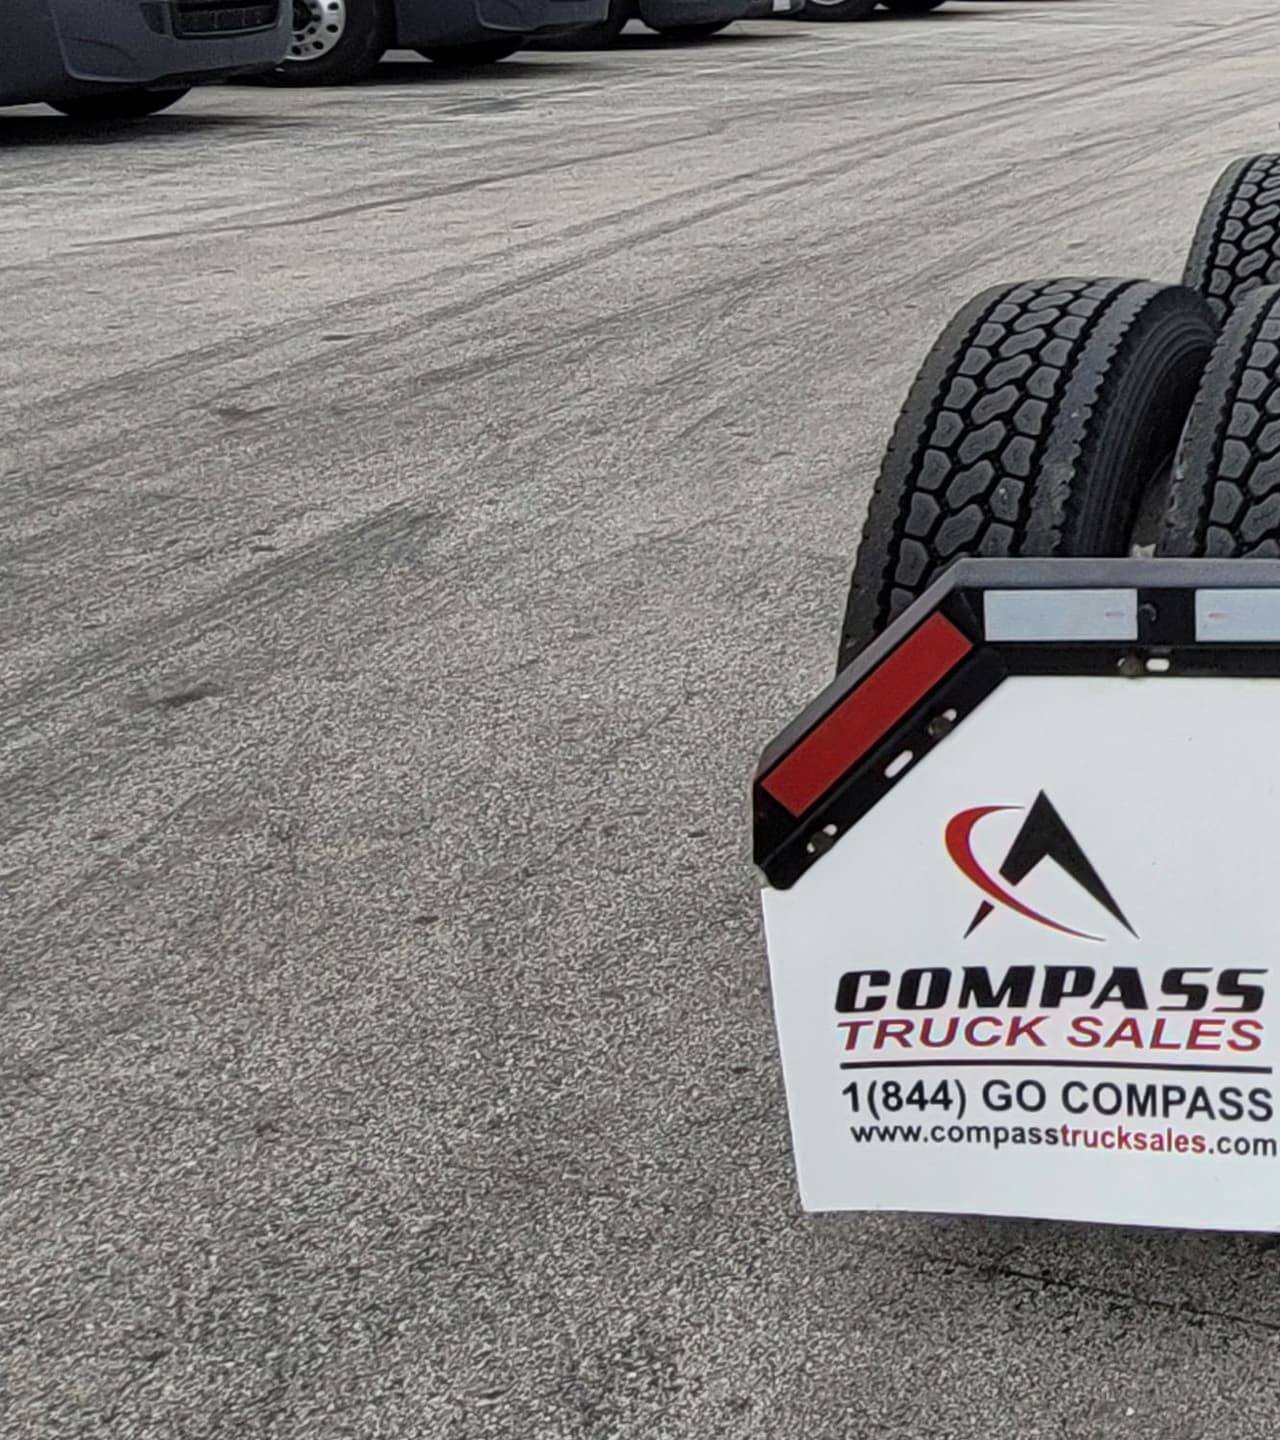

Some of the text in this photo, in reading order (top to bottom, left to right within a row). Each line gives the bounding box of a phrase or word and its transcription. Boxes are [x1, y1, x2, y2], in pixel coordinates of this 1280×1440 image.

[834, 964, 1269, 1014] COMPASS
[837, 1015, 1264, 1052] TRUCK SALES
[841, 1078, 1274, 1123] 1(844) GO COMPASS
[850, 1125, 1278, 1157] www.compasstrucksales.com
